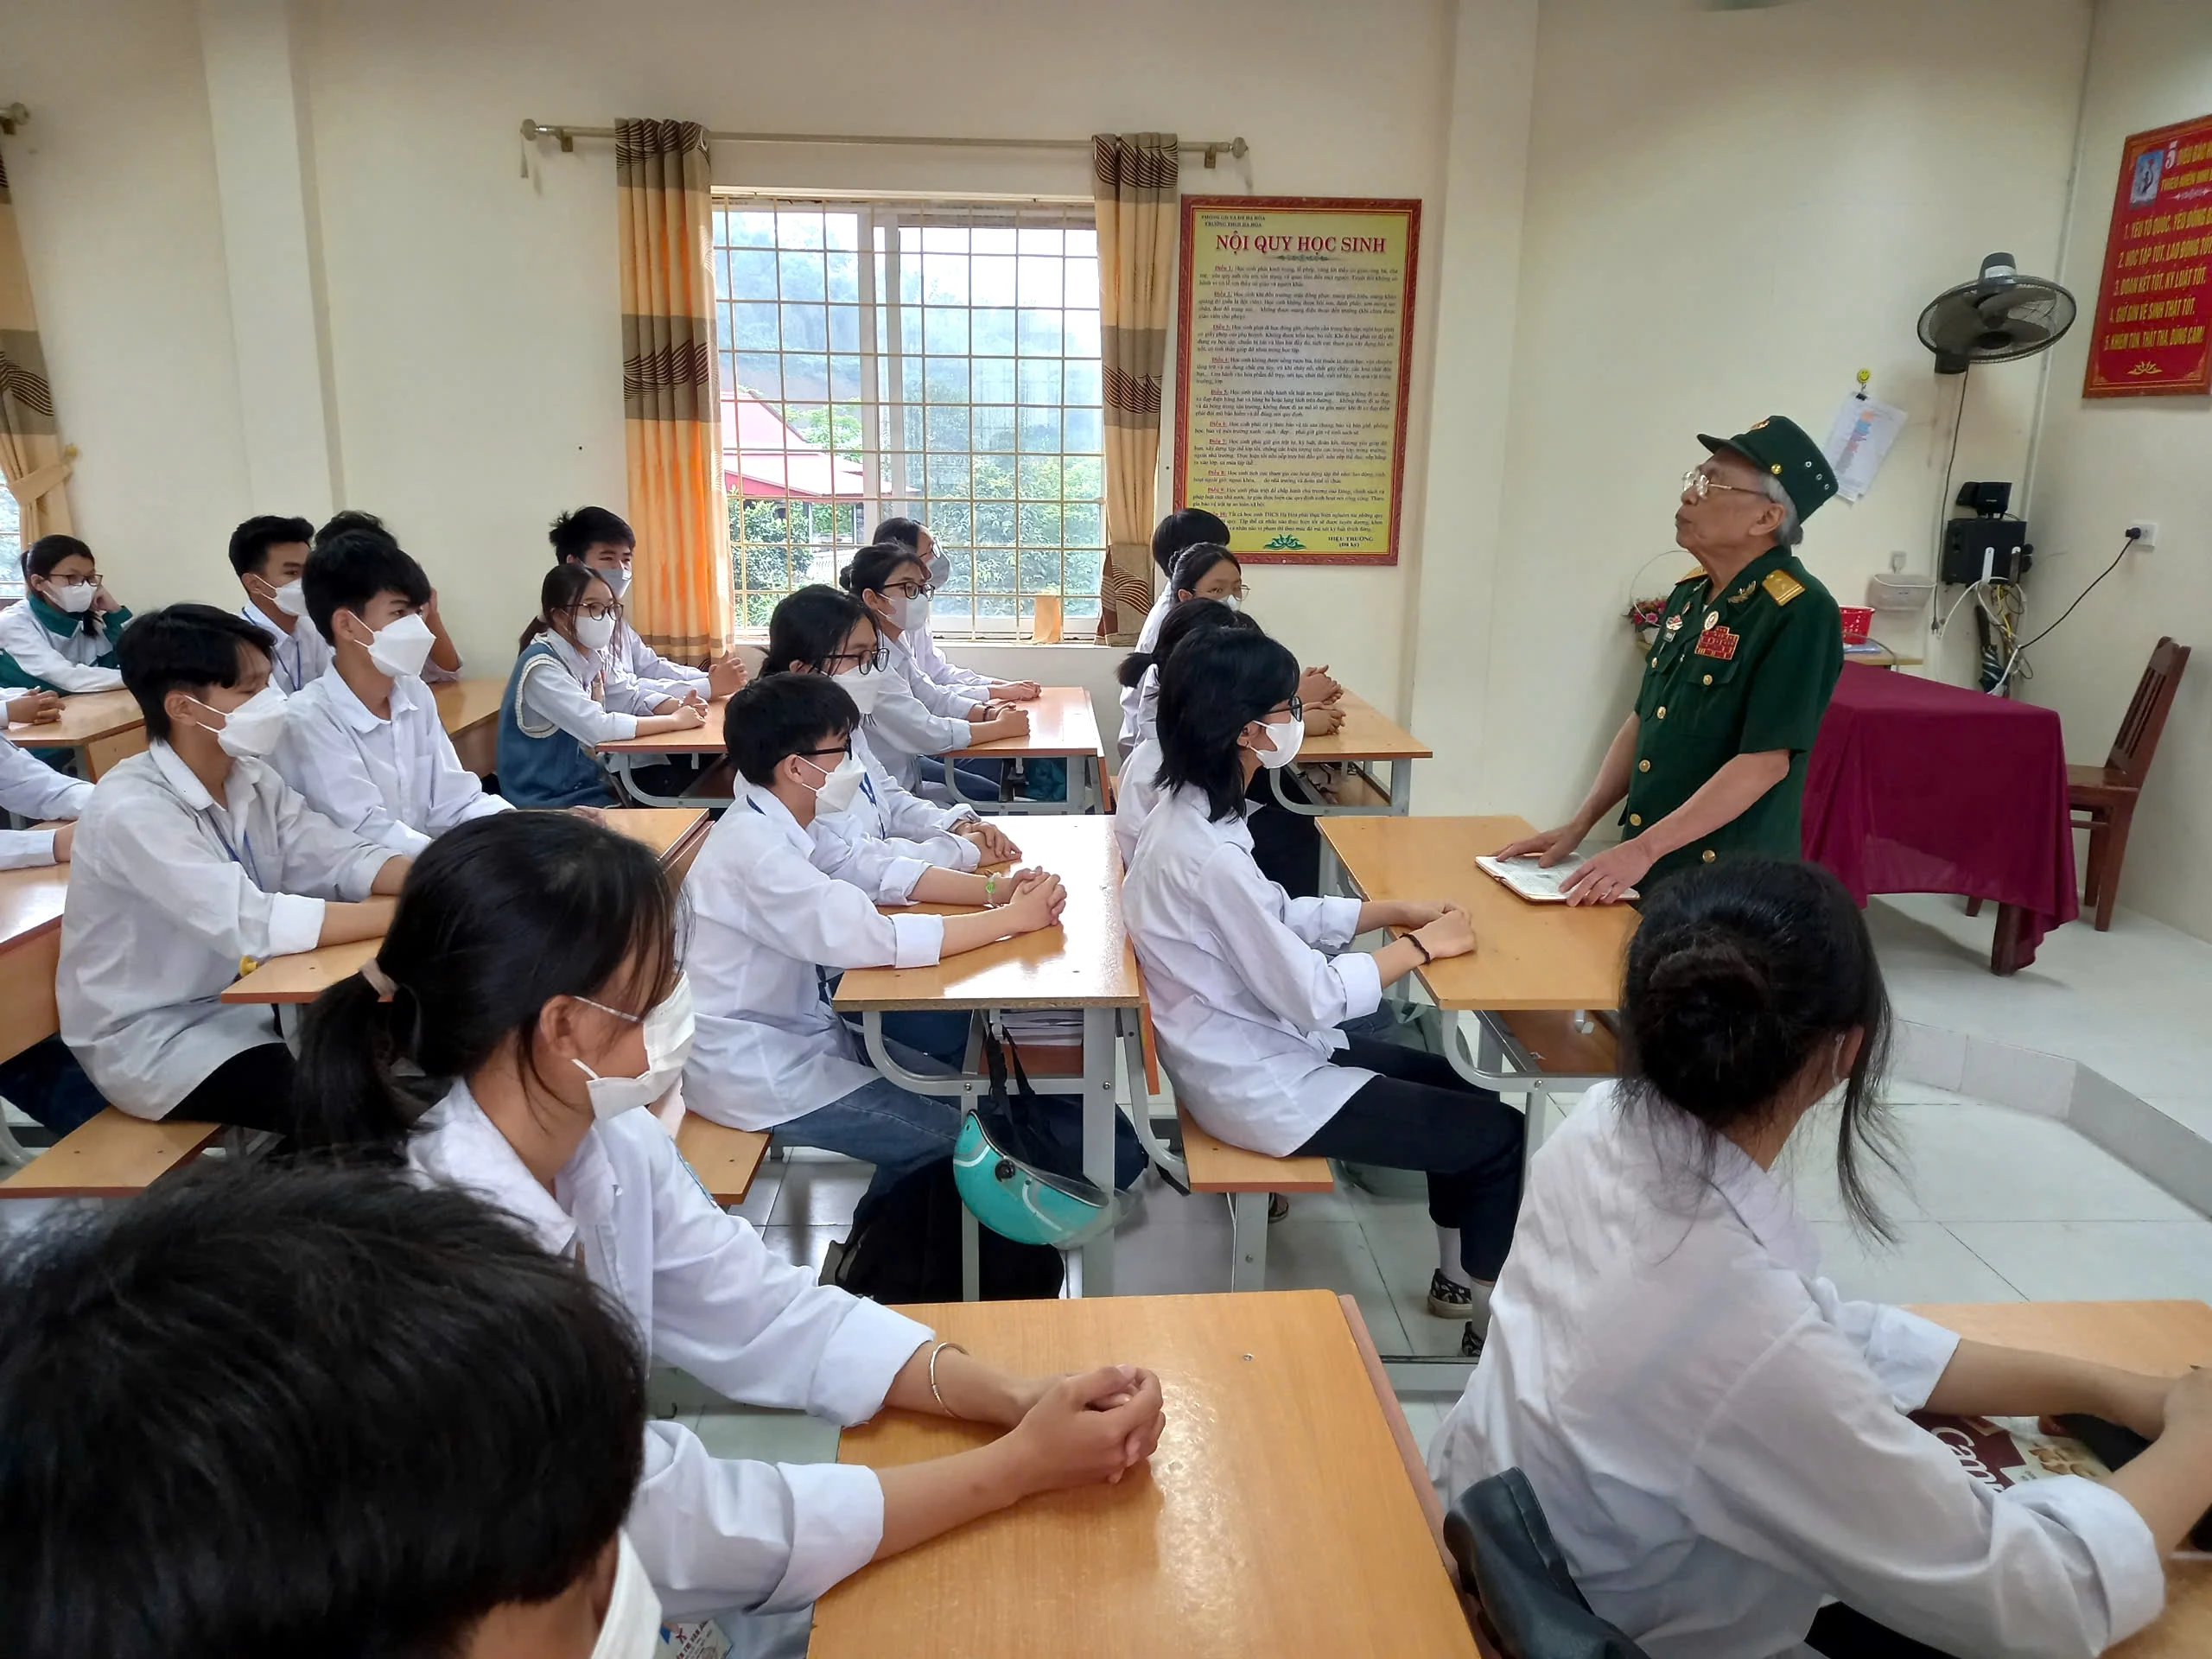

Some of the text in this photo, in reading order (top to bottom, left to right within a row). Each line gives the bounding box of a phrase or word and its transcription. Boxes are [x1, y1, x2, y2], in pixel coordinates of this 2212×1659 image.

[2165, 140, 2177, 168] 5
[1216, 230, 1386, 255] NỘI QUY HỌC SINH
